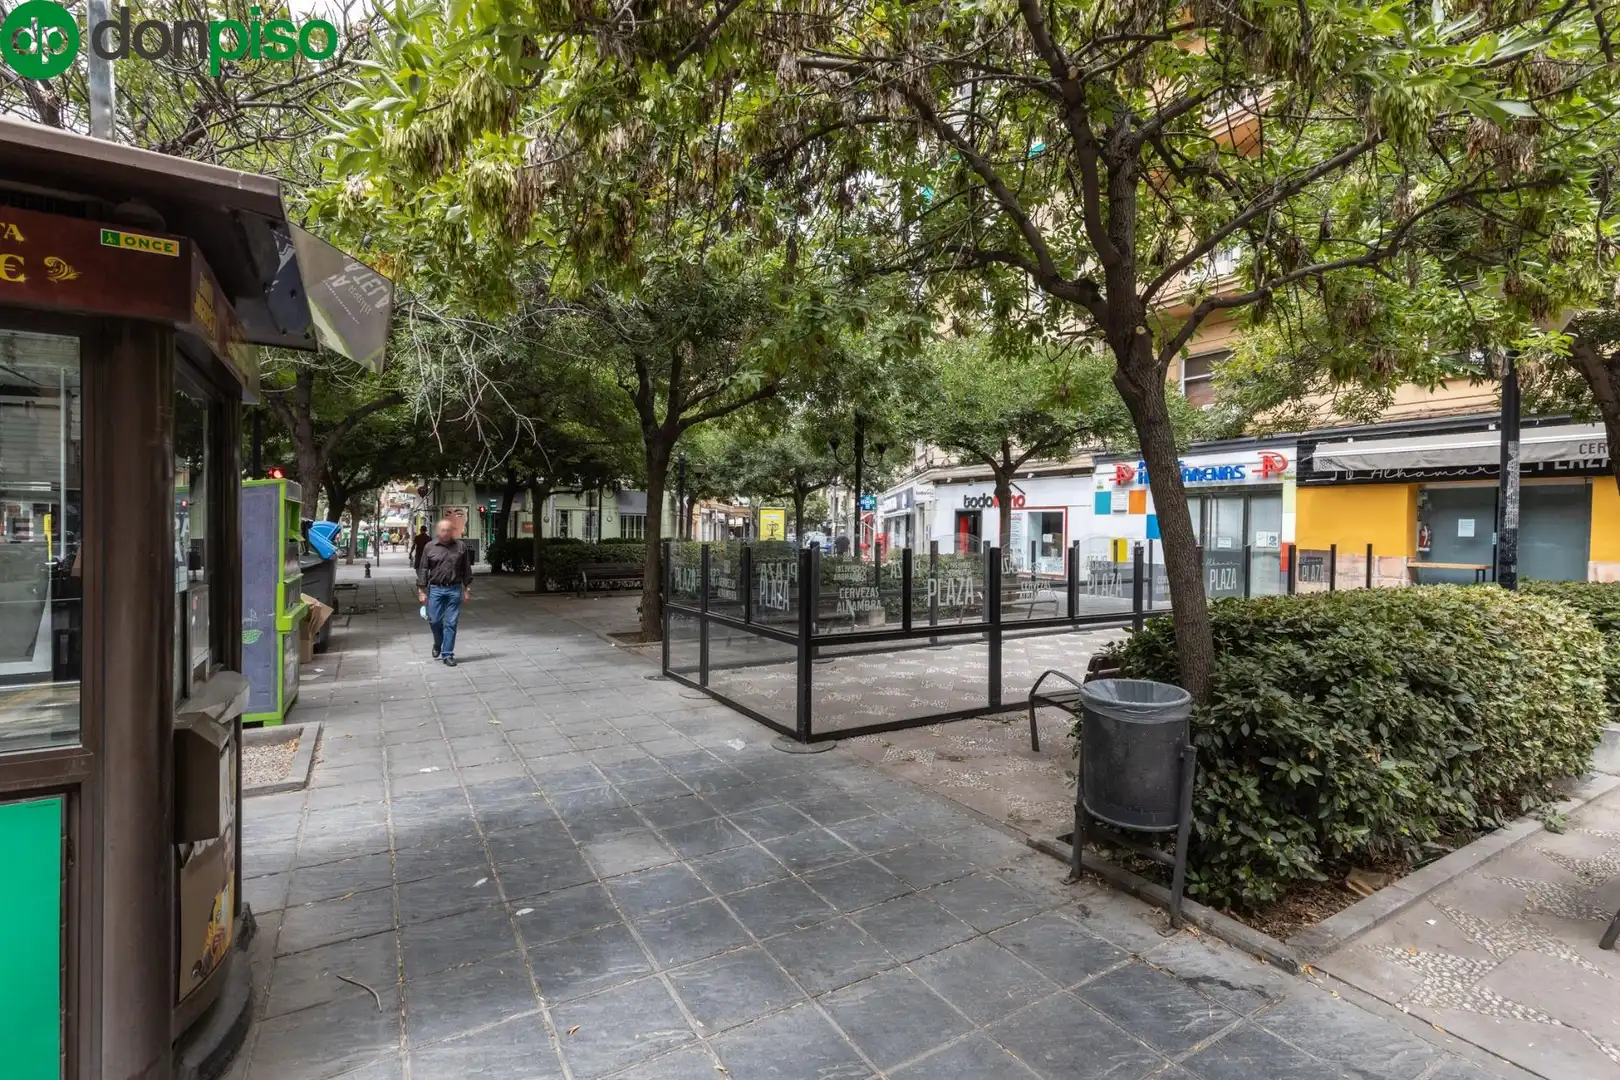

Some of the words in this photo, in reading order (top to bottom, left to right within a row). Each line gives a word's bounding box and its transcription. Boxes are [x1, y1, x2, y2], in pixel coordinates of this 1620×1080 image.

[124, 236, 174, 253] ONCE
[1087, 572, 1123, 598] PLAZA
[1209, 568, 1237, 591] PLAZA
[759, 579, 790, 612] PLAZA
[839, 586, 880, 599] CERVEZAS
[926, 577, 975, 607] PLAZA
[836, 599, 881, 613] ALHAMBRA
